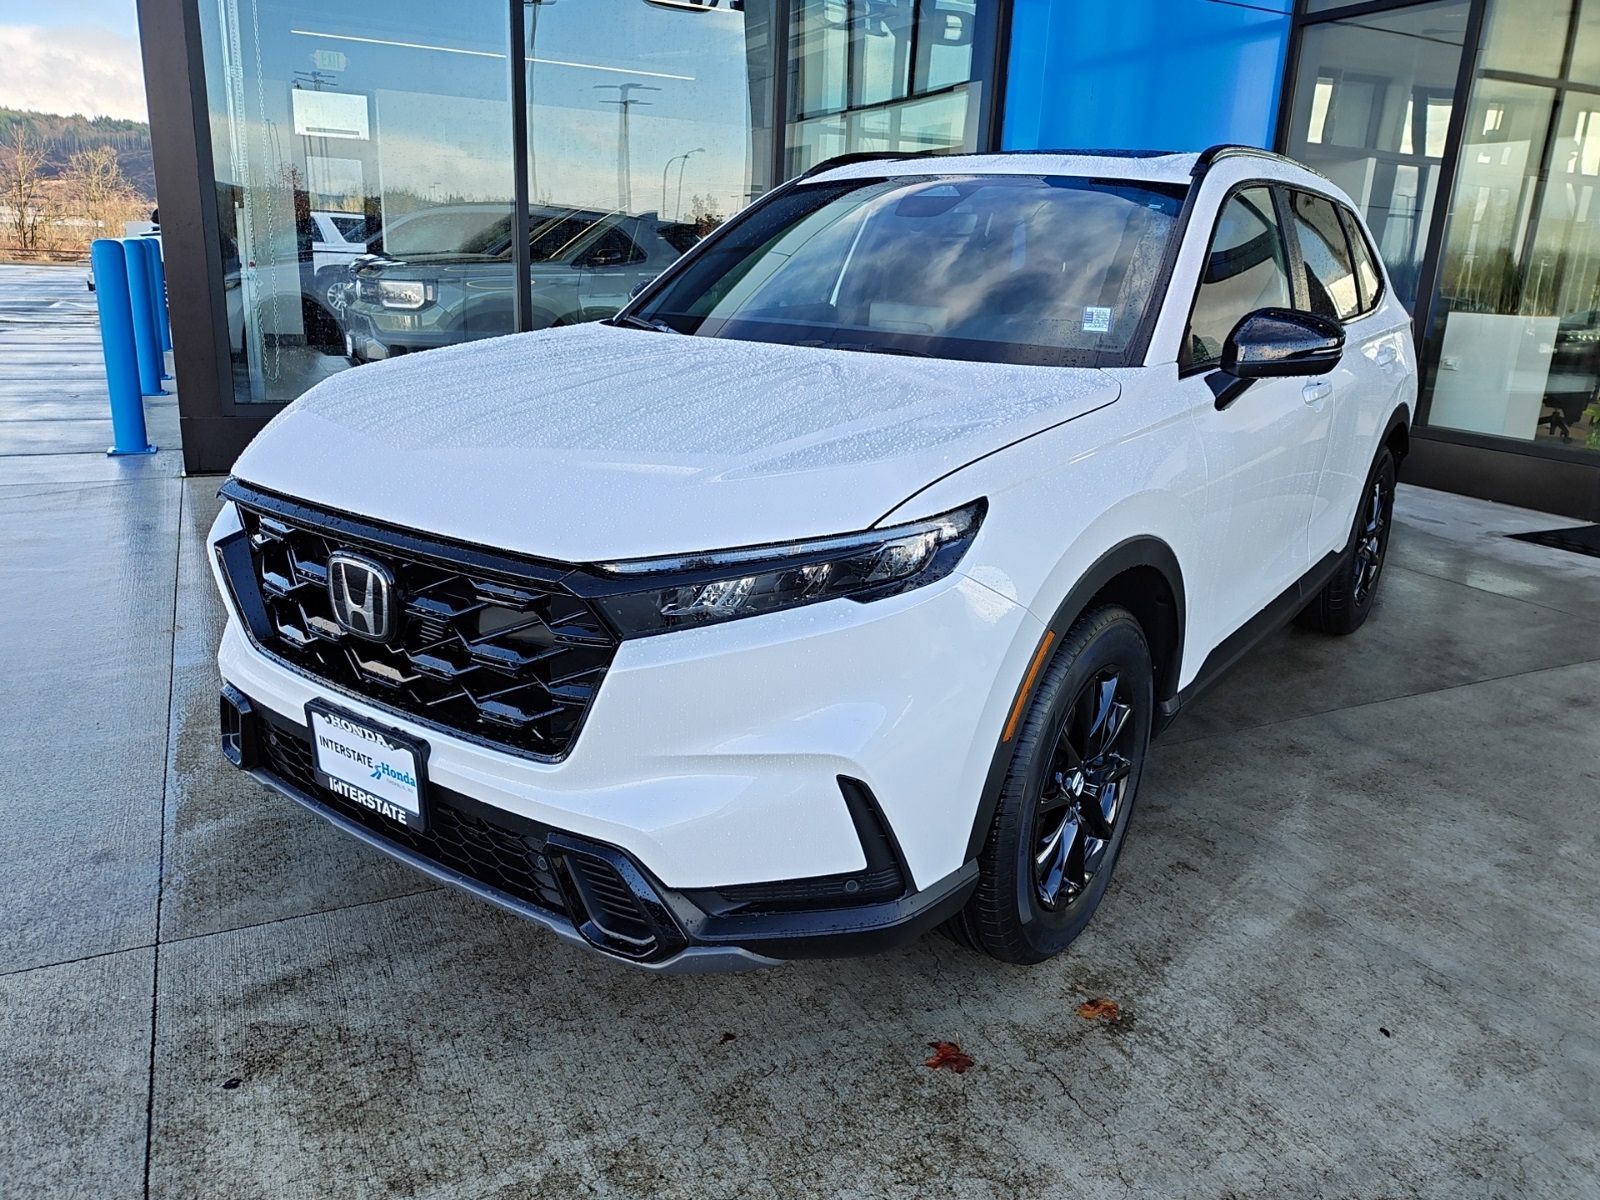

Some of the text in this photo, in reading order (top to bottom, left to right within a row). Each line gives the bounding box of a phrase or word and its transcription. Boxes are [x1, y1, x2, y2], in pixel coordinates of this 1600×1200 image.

[329, 714, 390, 747] HONDA
[319, 735, 374, 769] INTERSTATE
[380, 762, 416, 787] Honda
[329, 776, 408, 825] INTERSTATE
